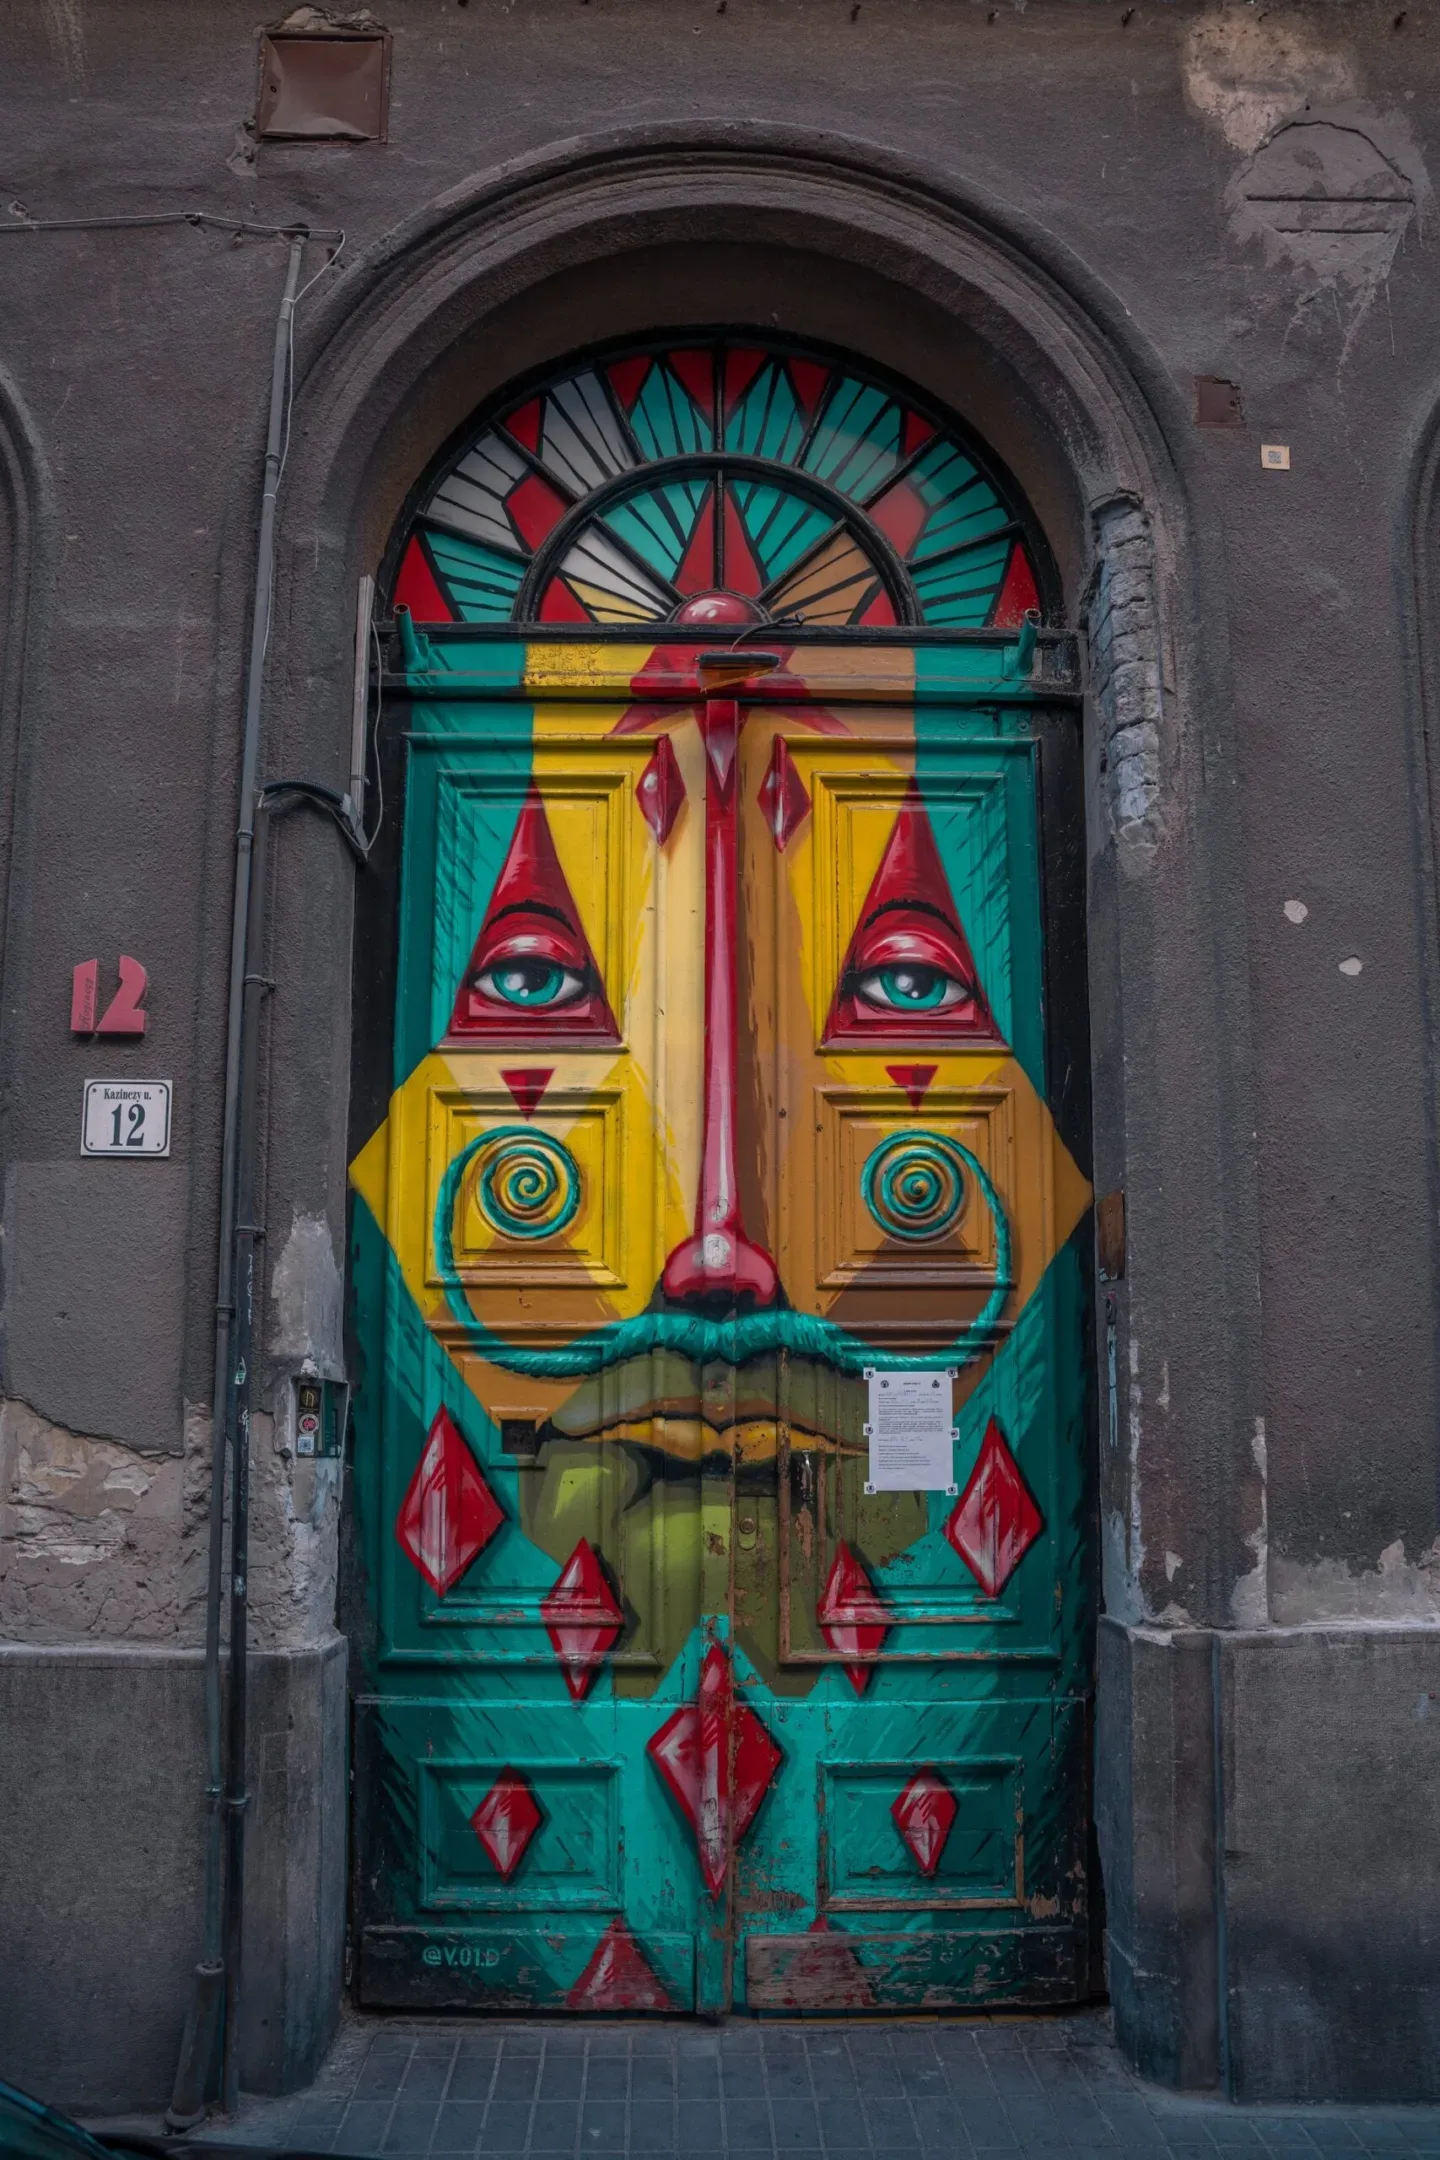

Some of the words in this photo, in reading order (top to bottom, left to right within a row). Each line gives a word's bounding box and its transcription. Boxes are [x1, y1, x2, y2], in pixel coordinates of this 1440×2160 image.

[71, 954, 147, 1032] 12
[104, 1088, 142, 1102] Kazinczy
[144, 1091, 152, 1100] u.
[110, 1103, 146, 1146] 12
[422, 1945, 500, 1967] @V.01.D
